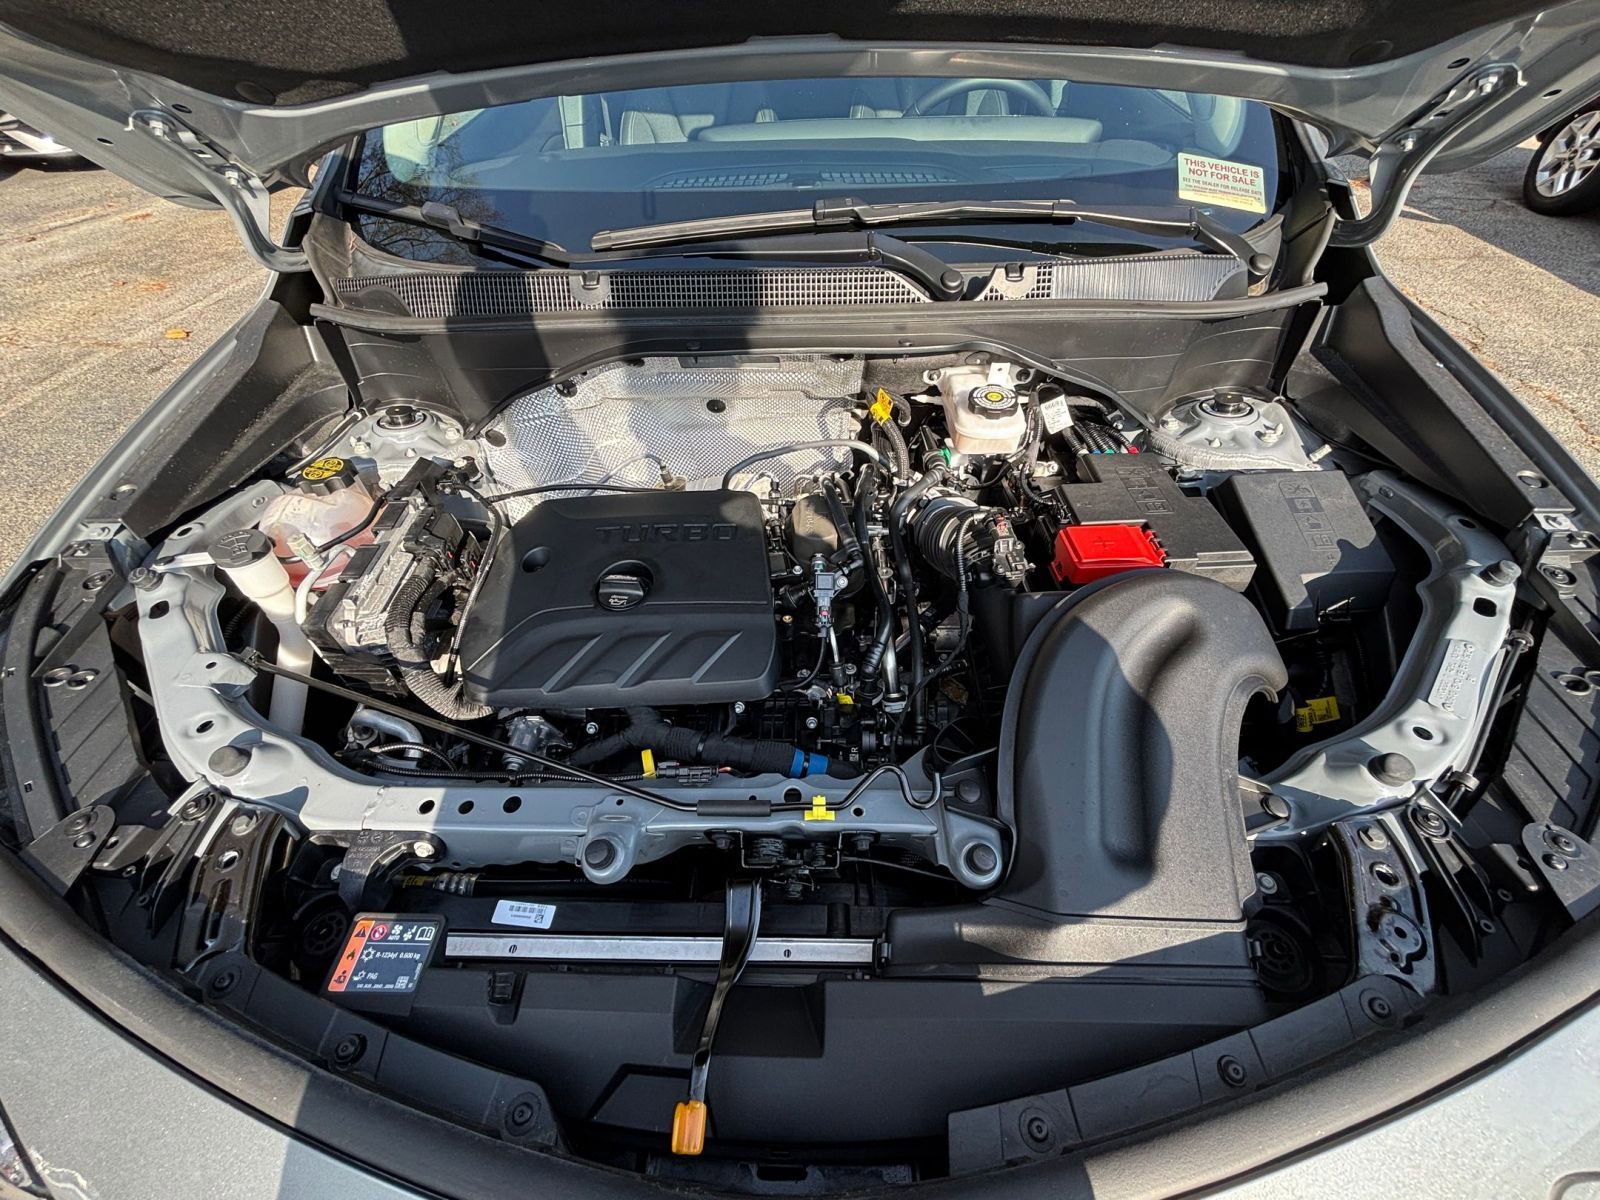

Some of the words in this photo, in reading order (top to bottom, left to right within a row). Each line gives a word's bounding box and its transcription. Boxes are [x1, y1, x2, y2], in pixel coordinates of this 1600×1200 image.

[1184, 158, 1206, 168] THIS
[1208, 162, 1249, 177] VEHICLE
[1250, 169, 1260, 179] IS
[1188, 167, 1208, 177] NOT
[1210, 171, 1230, 181] FOR
[1232, 176, 1256, 187] SALE
[595, 523, 739, 544] TURBO
[366, 972, 379, 980] PAG
